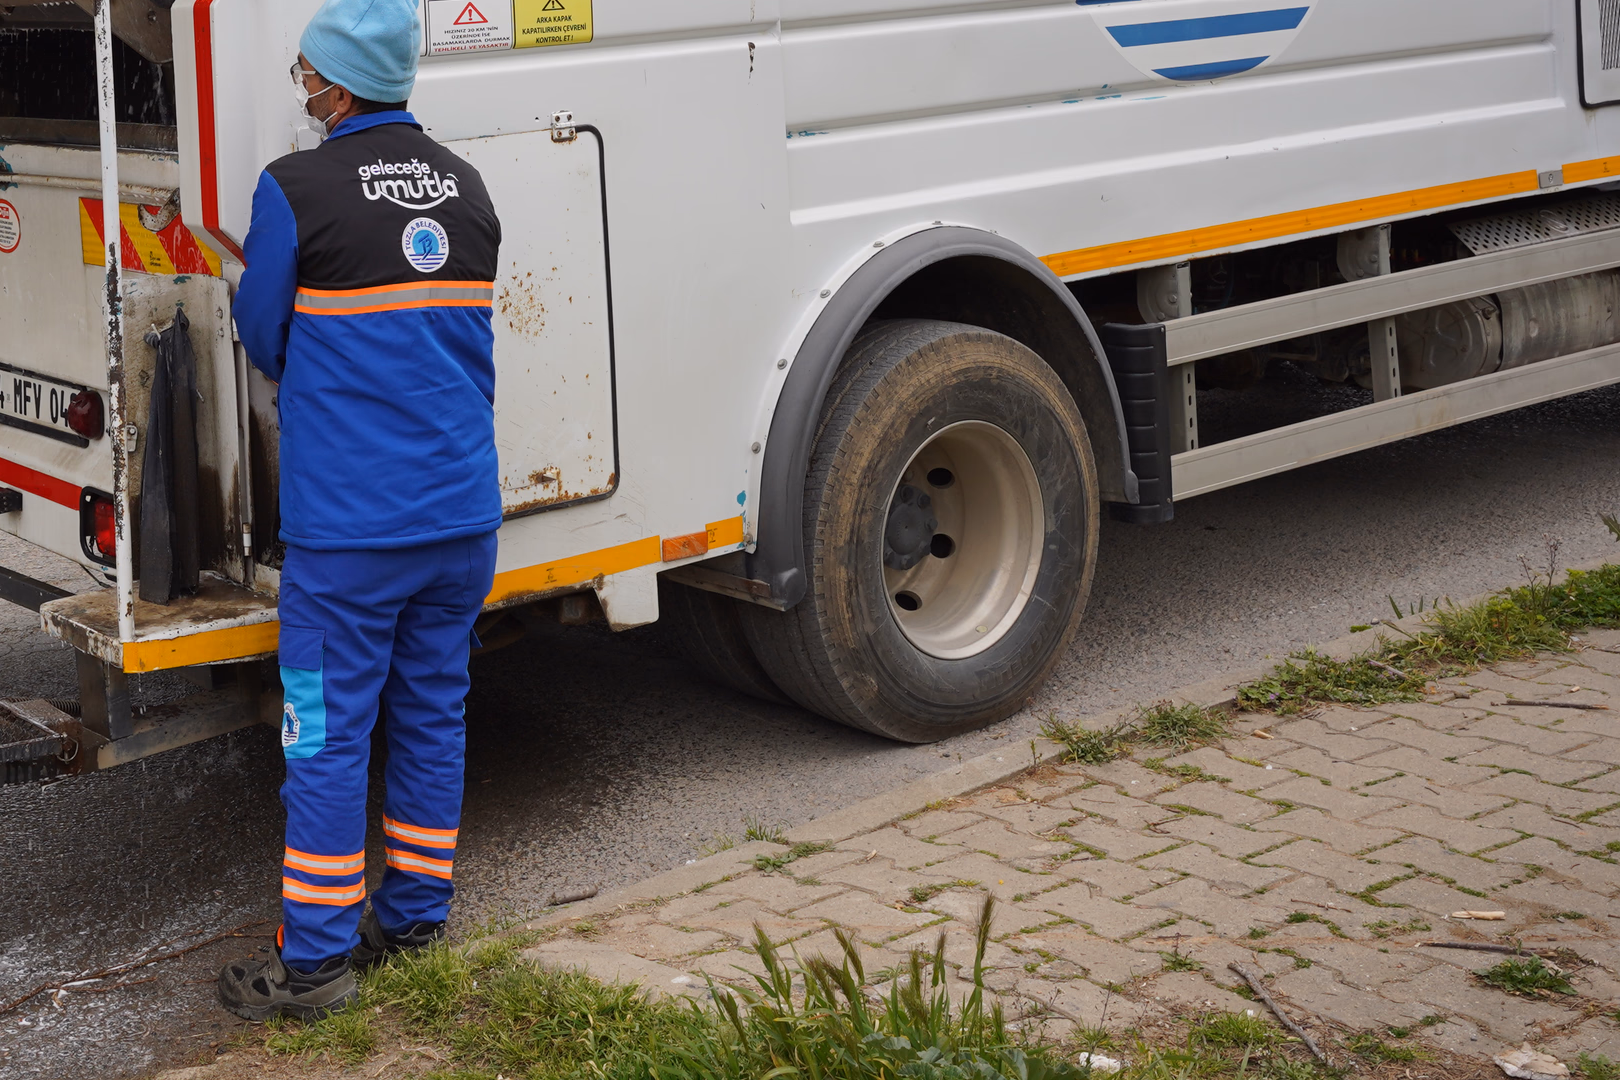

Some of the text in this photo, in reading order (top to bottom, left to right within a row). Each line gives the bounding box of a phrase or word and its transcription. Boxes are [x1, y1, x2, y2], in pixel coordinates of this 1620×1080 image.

[522, 23, 586, 34] KAPATILIRKEN ÇEVRENİ
[358, 158, 431, 181] geleceğe
[361, 171, 460, 201] umutla
[405, 226, 416, 250] TUZLA
[13, 377, 42, 420] MFV
[49, 387, 77, 428] 04
